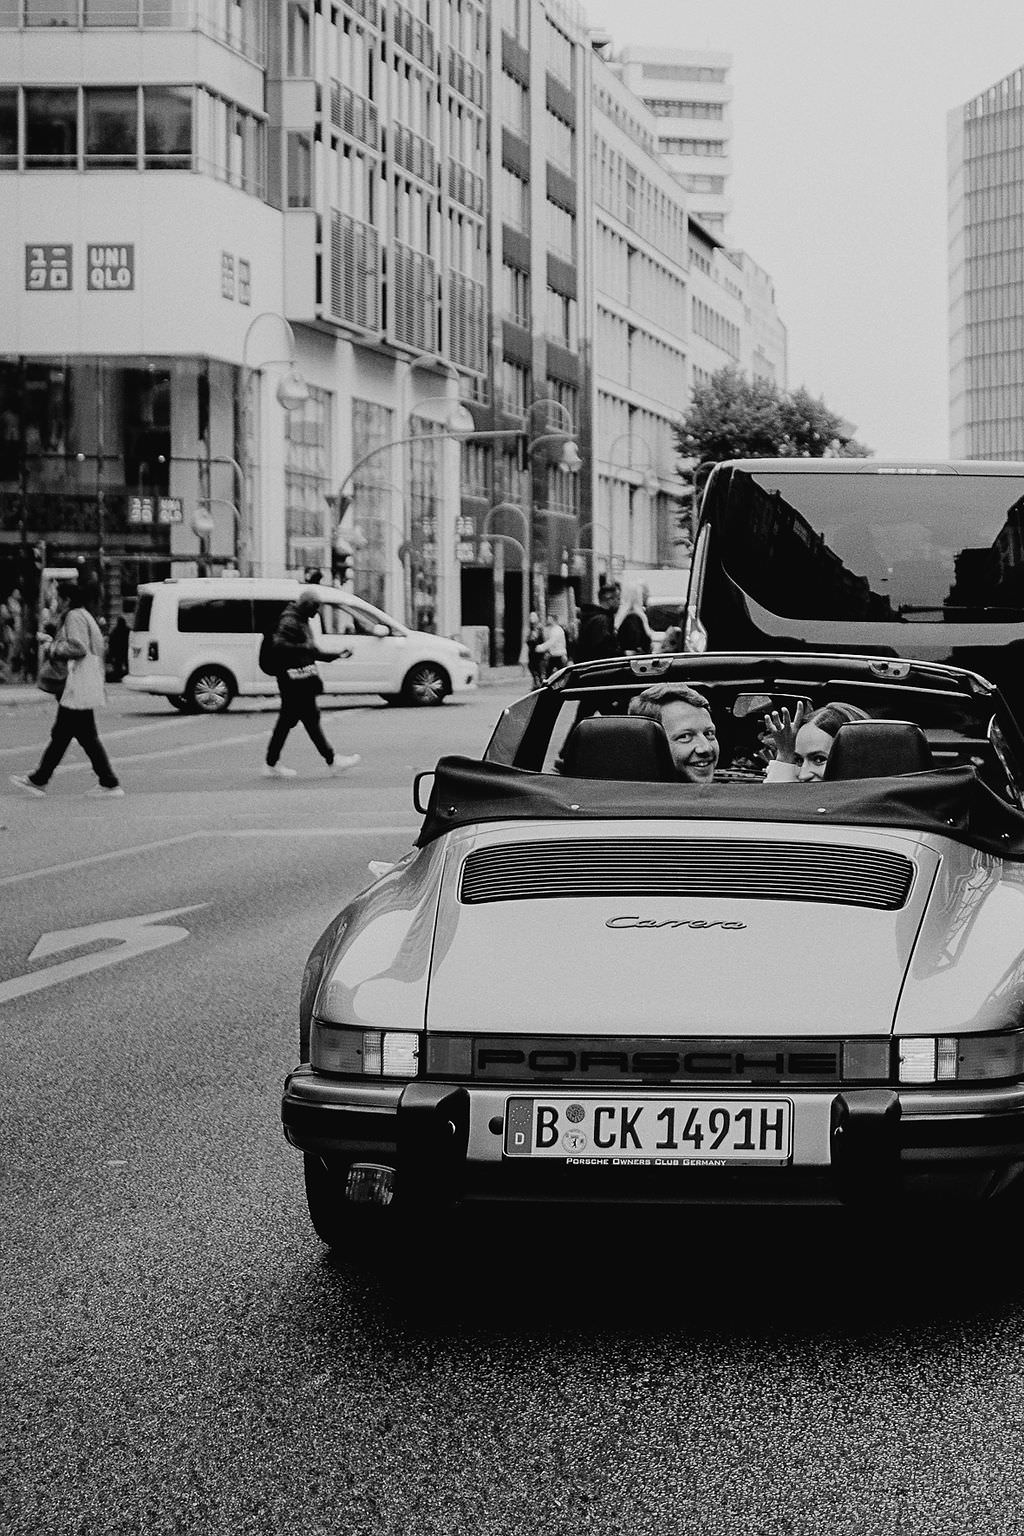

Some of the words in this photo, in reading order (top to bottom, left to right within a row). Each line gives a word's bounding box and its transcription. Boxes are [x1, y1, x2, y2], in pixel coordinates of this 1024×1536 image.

[90, 247, 128, 267] UNI
[90, 267, 132, 289] QLO
[604, 915, 748, 930] Carrera
[477, 1048, 837, 1075] PORSCHE
[514, 1133, 525, 1145] D
[535, 1106, 560, 1148] B
[593, 1106, 644, 1150] CK
[656, 1107, 784, 1151] 1491H
